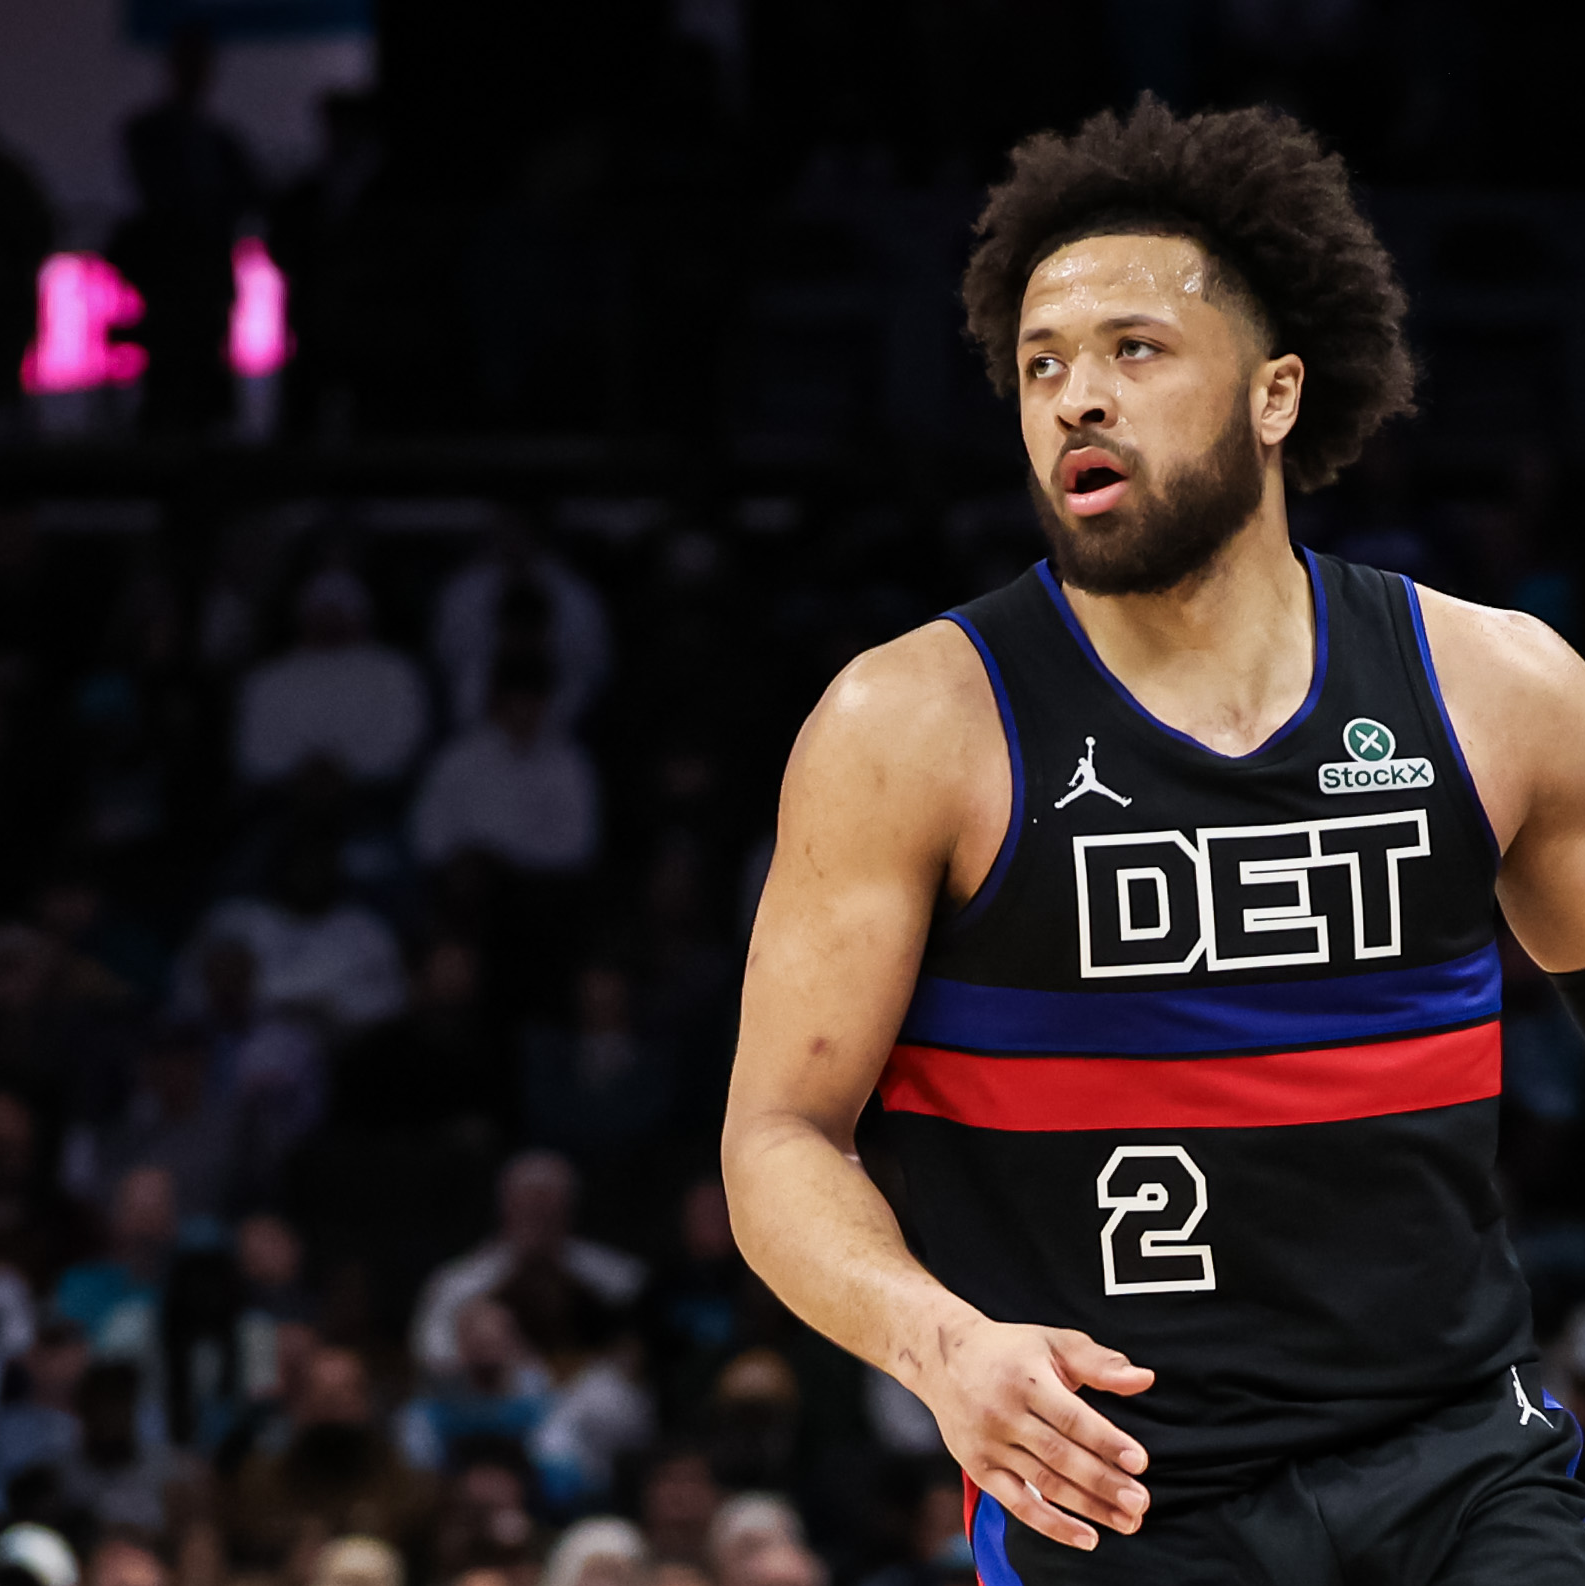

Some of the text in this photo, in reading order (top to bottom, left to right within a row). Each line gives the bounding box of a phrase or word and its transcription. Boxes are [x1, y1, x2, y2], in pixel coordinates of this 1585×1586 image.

[1323, 762, 1429, 789] StockX
[1072, 808, 1432, 979] DET
[1096, 1145, 1216, 1296] 2
